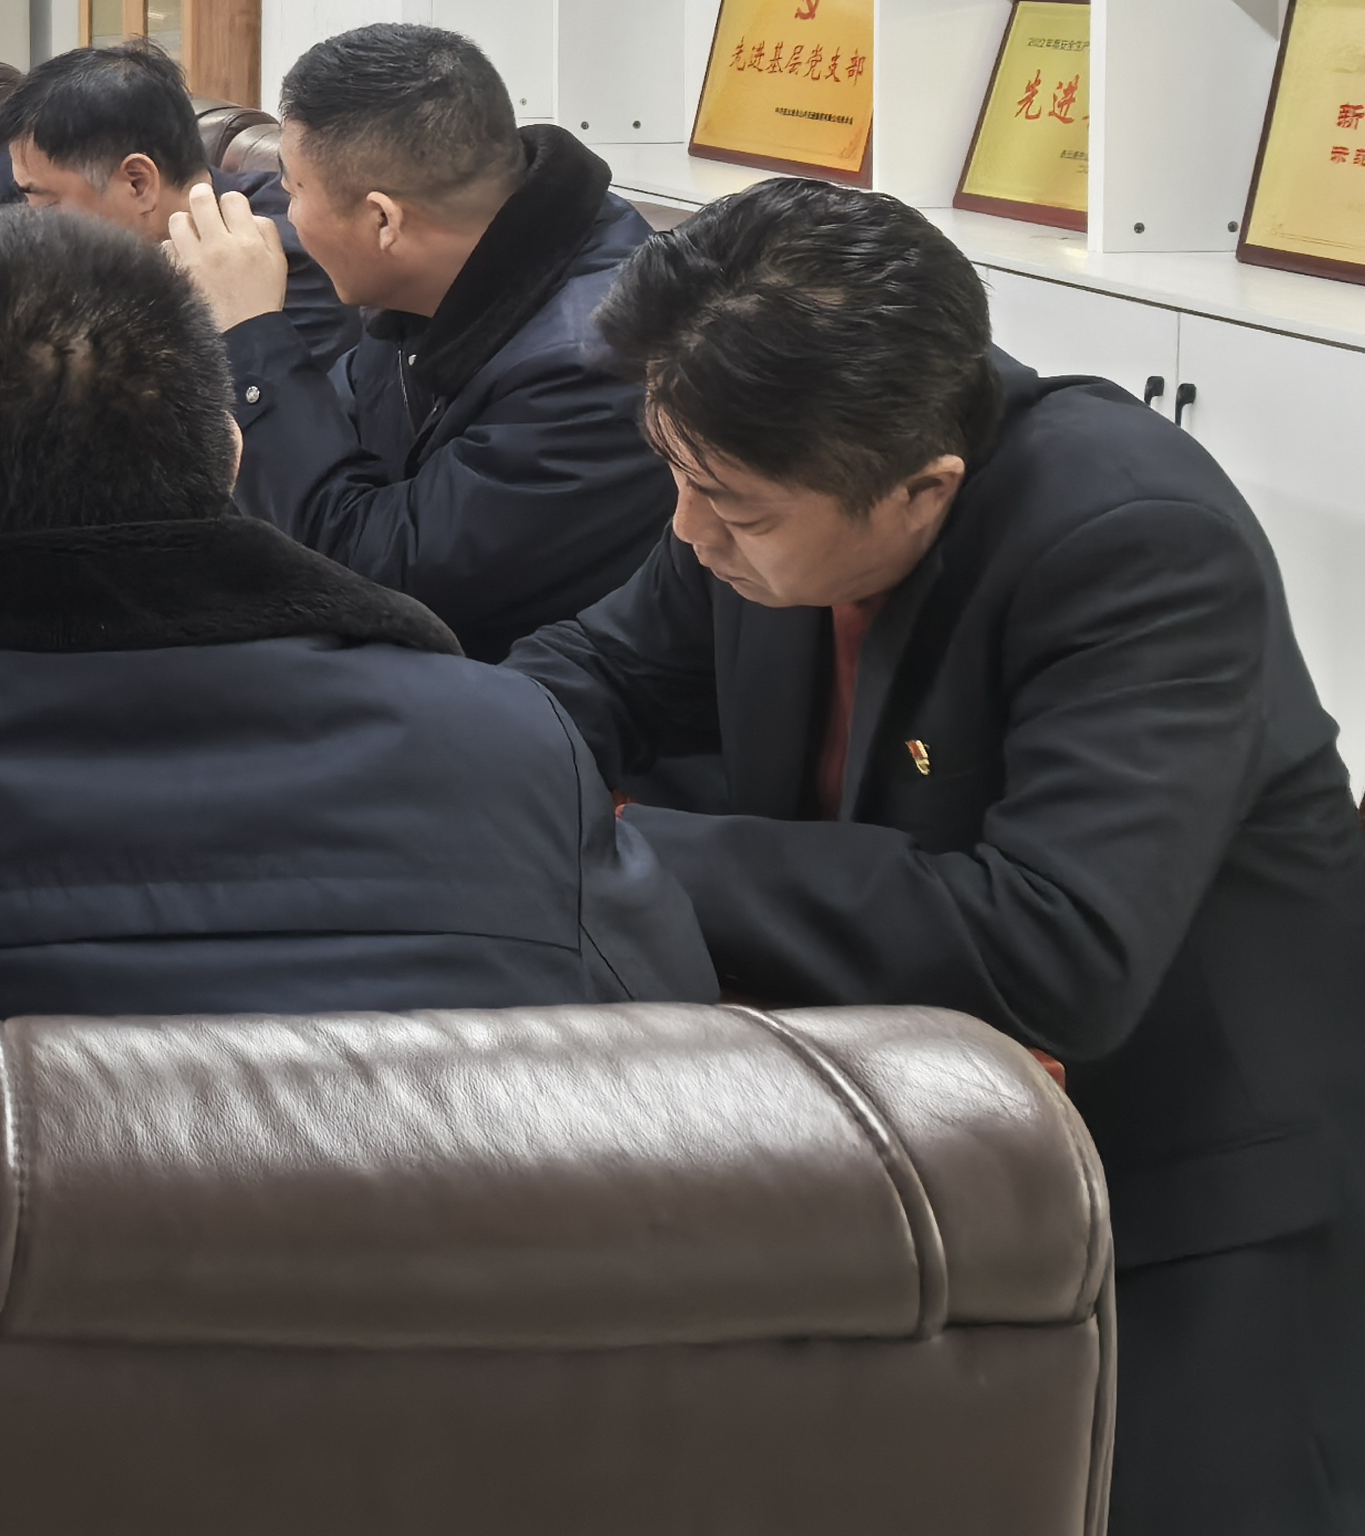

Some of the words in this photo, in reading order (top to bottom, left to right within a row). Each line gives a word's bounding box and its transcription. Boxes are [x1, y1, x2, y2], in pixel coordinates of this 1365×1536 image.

[729, 36, 866, 86] 先进基层党支部
[1015, 69, 1089, 124] 先进
